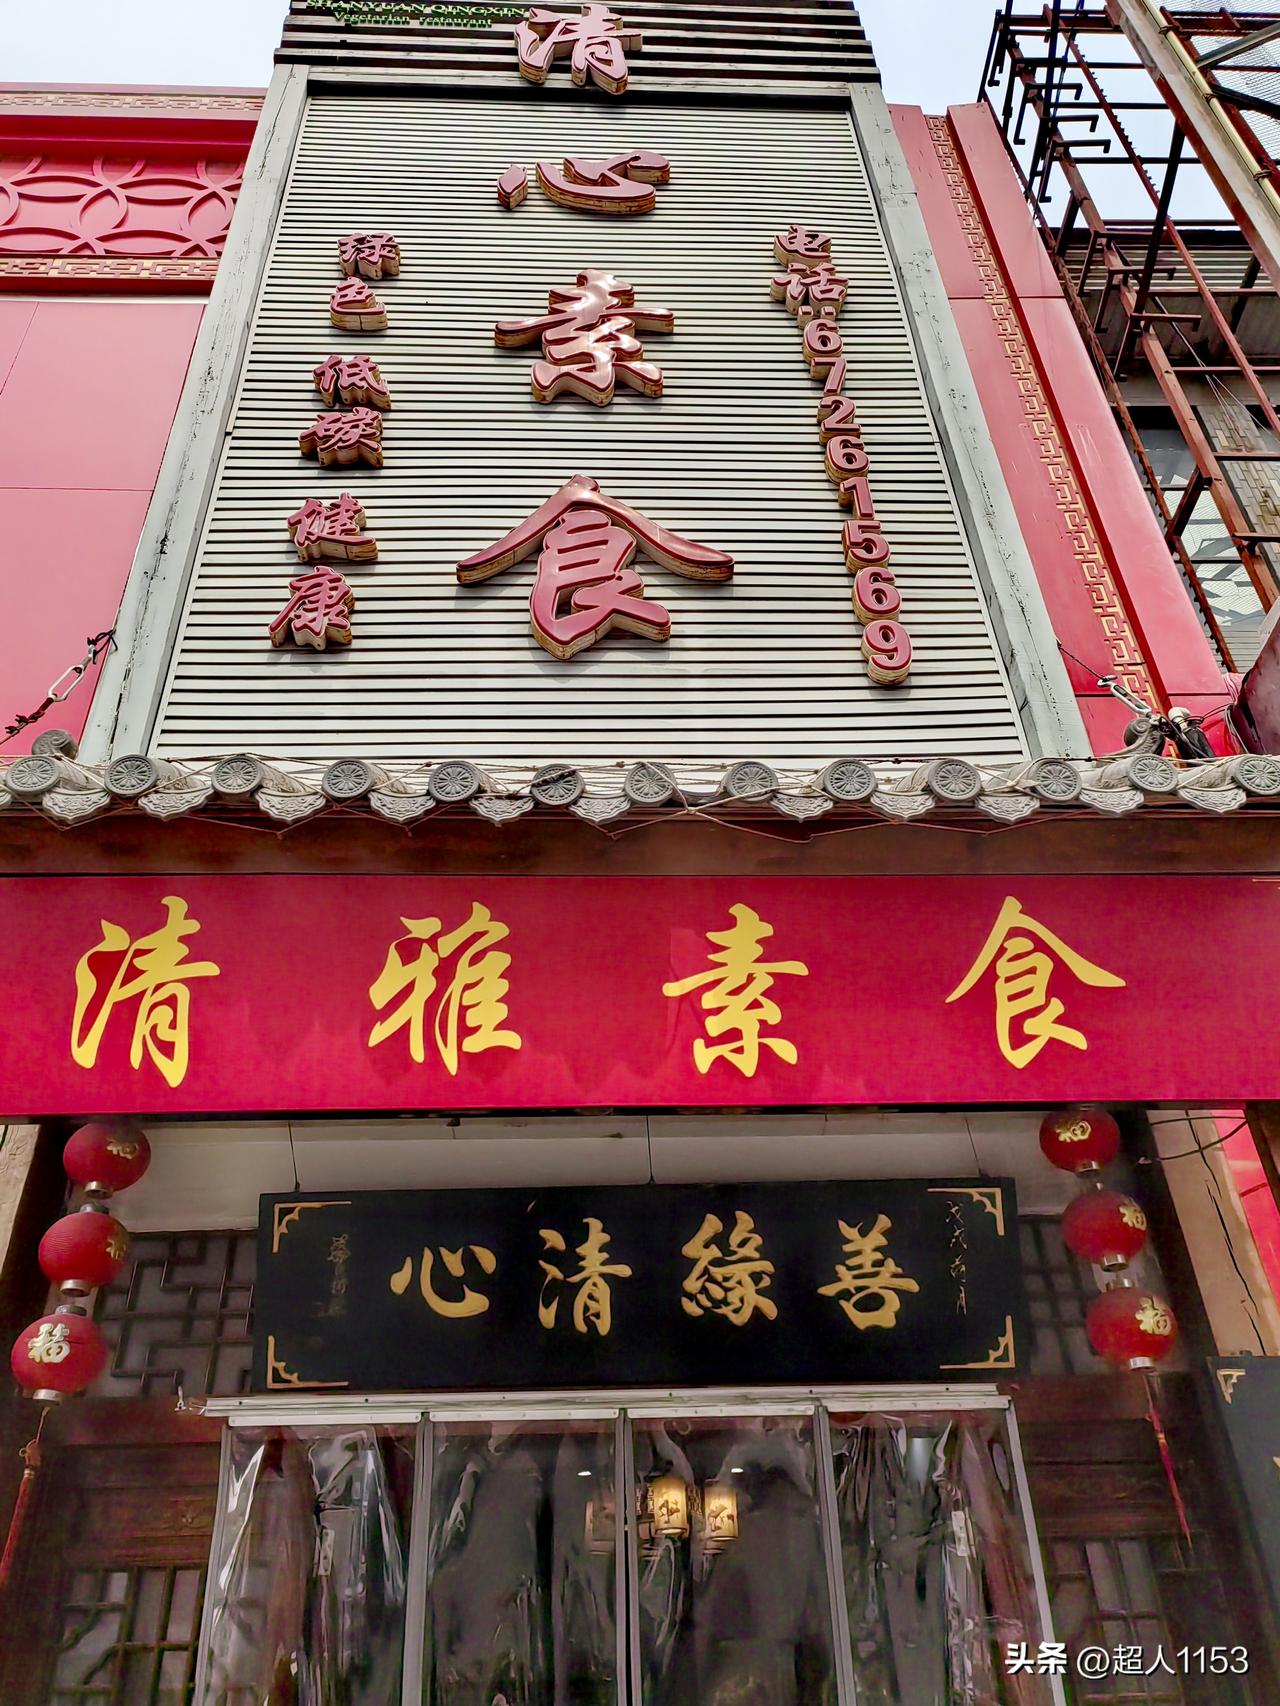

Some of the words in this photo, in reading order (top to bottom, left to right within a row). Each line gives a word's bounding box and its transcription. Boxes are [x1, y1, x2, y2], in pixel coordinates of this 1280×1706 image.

[334, 11, 410, 23] Vegetarian
[419, 16, 492, 27] restaurant
[430, 4, 525, 17] QINGXIN
[456, 4, 734, 660] 清心素食
[70, 895, 1127, 1089] 清雅素食
[27, 1322, 71, 1364] 福
